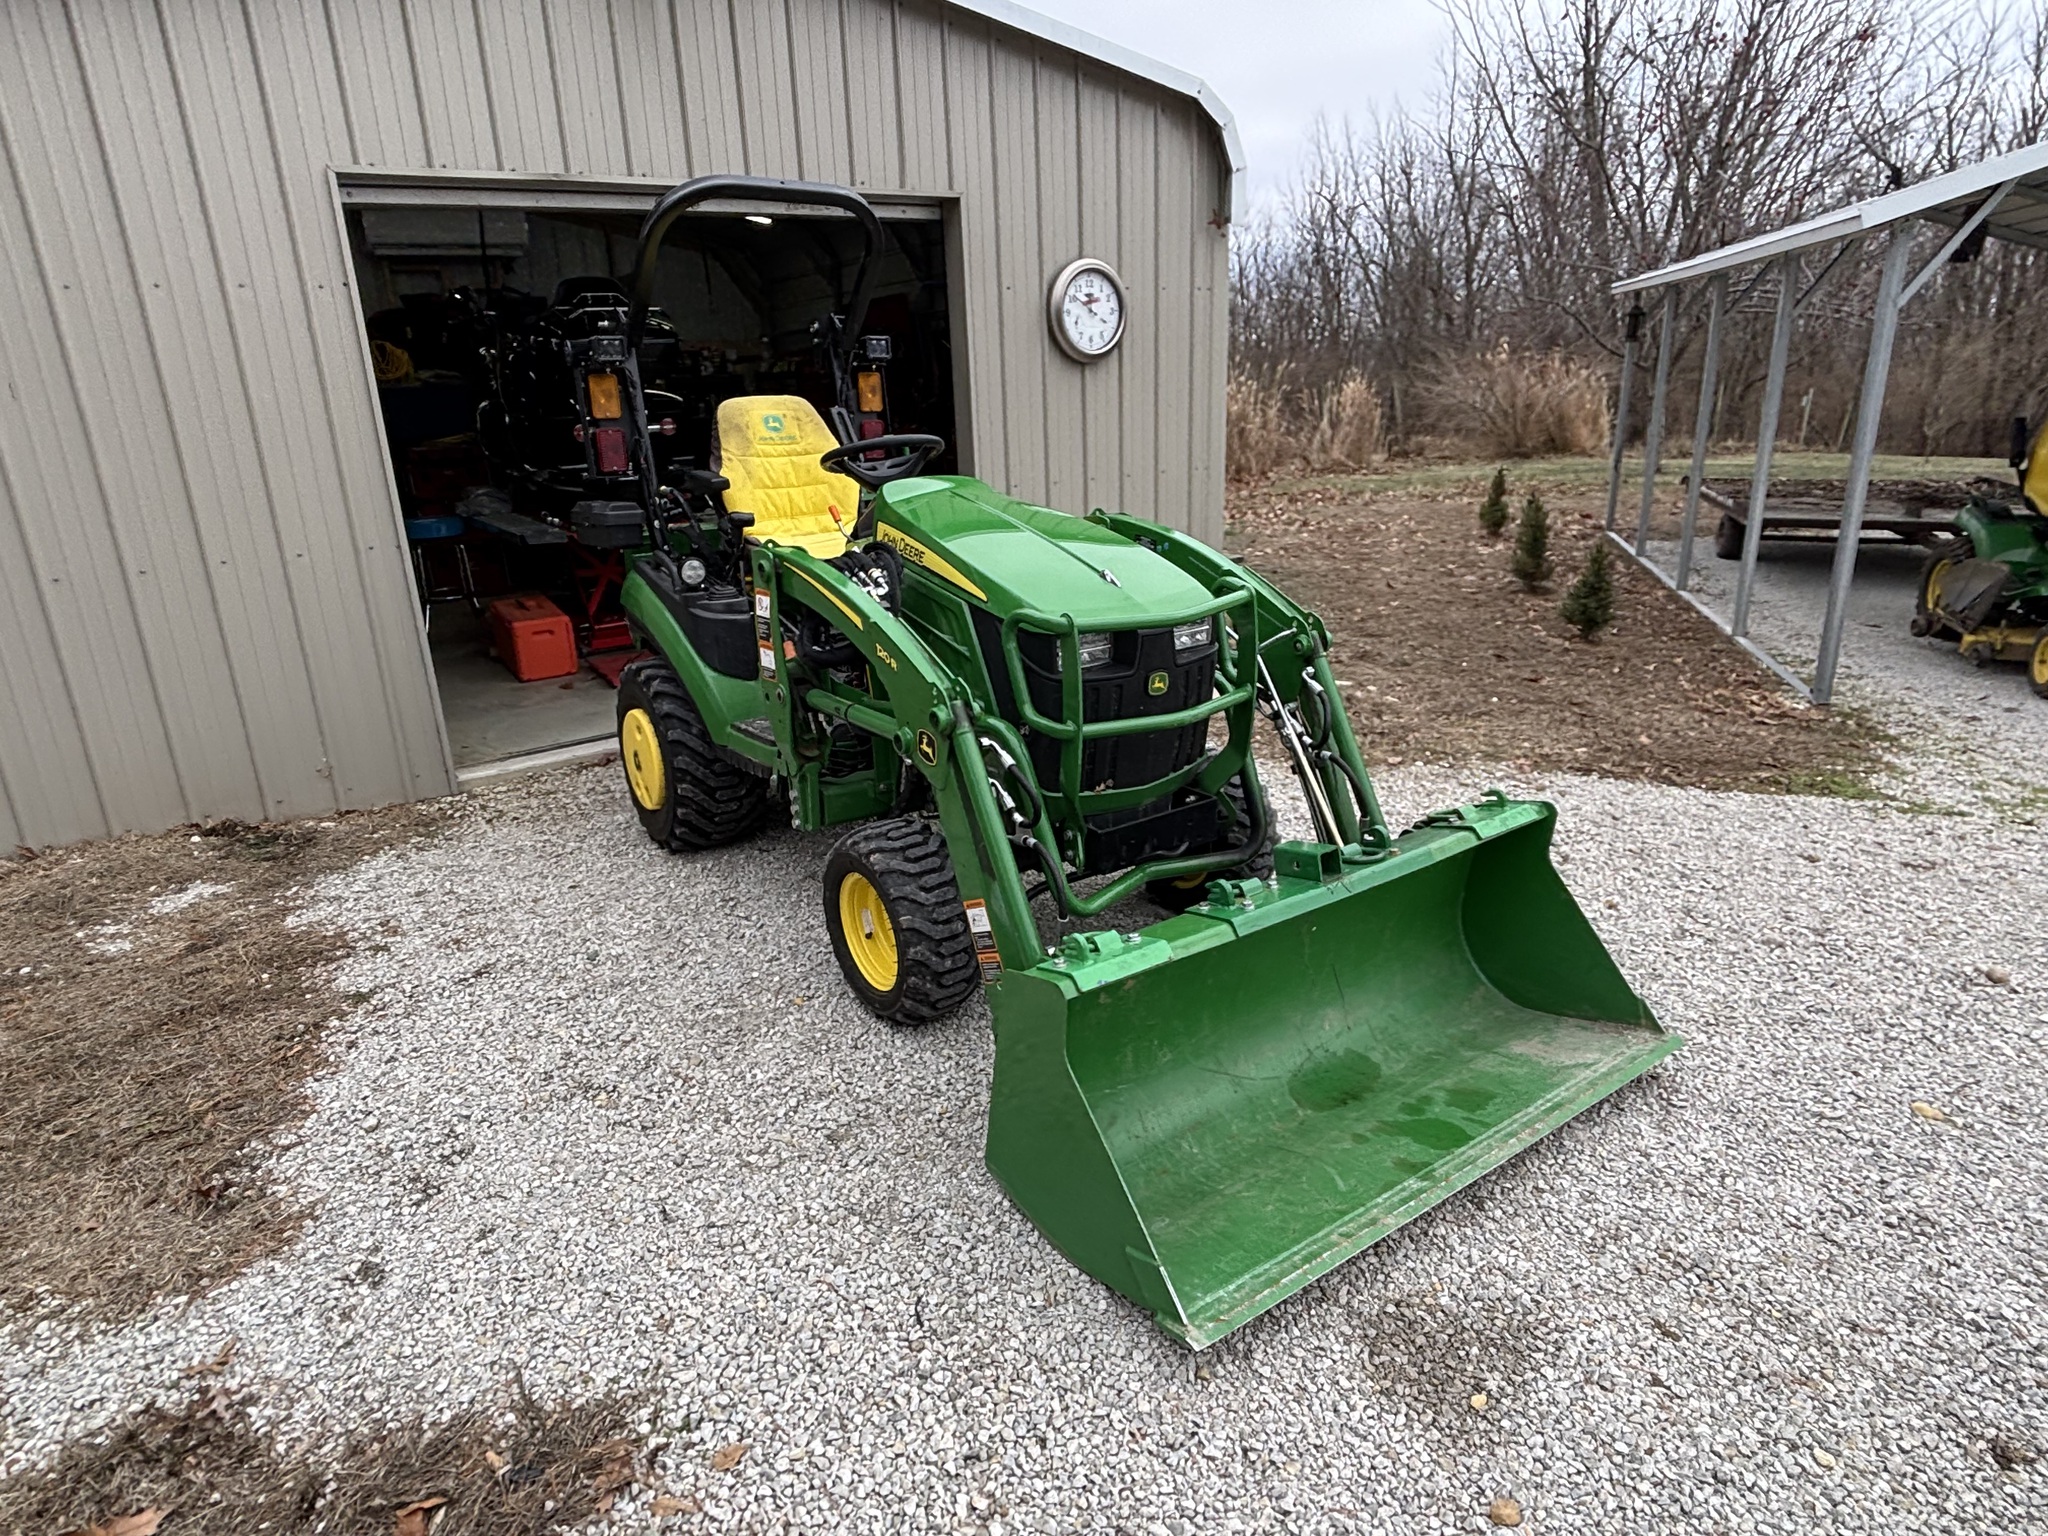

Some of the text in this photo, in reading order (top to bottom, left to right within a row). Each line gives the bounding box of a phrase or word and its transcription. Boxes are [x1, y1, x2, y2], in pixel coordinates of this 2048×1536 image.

[1085, 280, 1094, 288] 12
[1074, 285, 1082, 293] 11
[881, 529, 926, 564] JOHN DEERE
